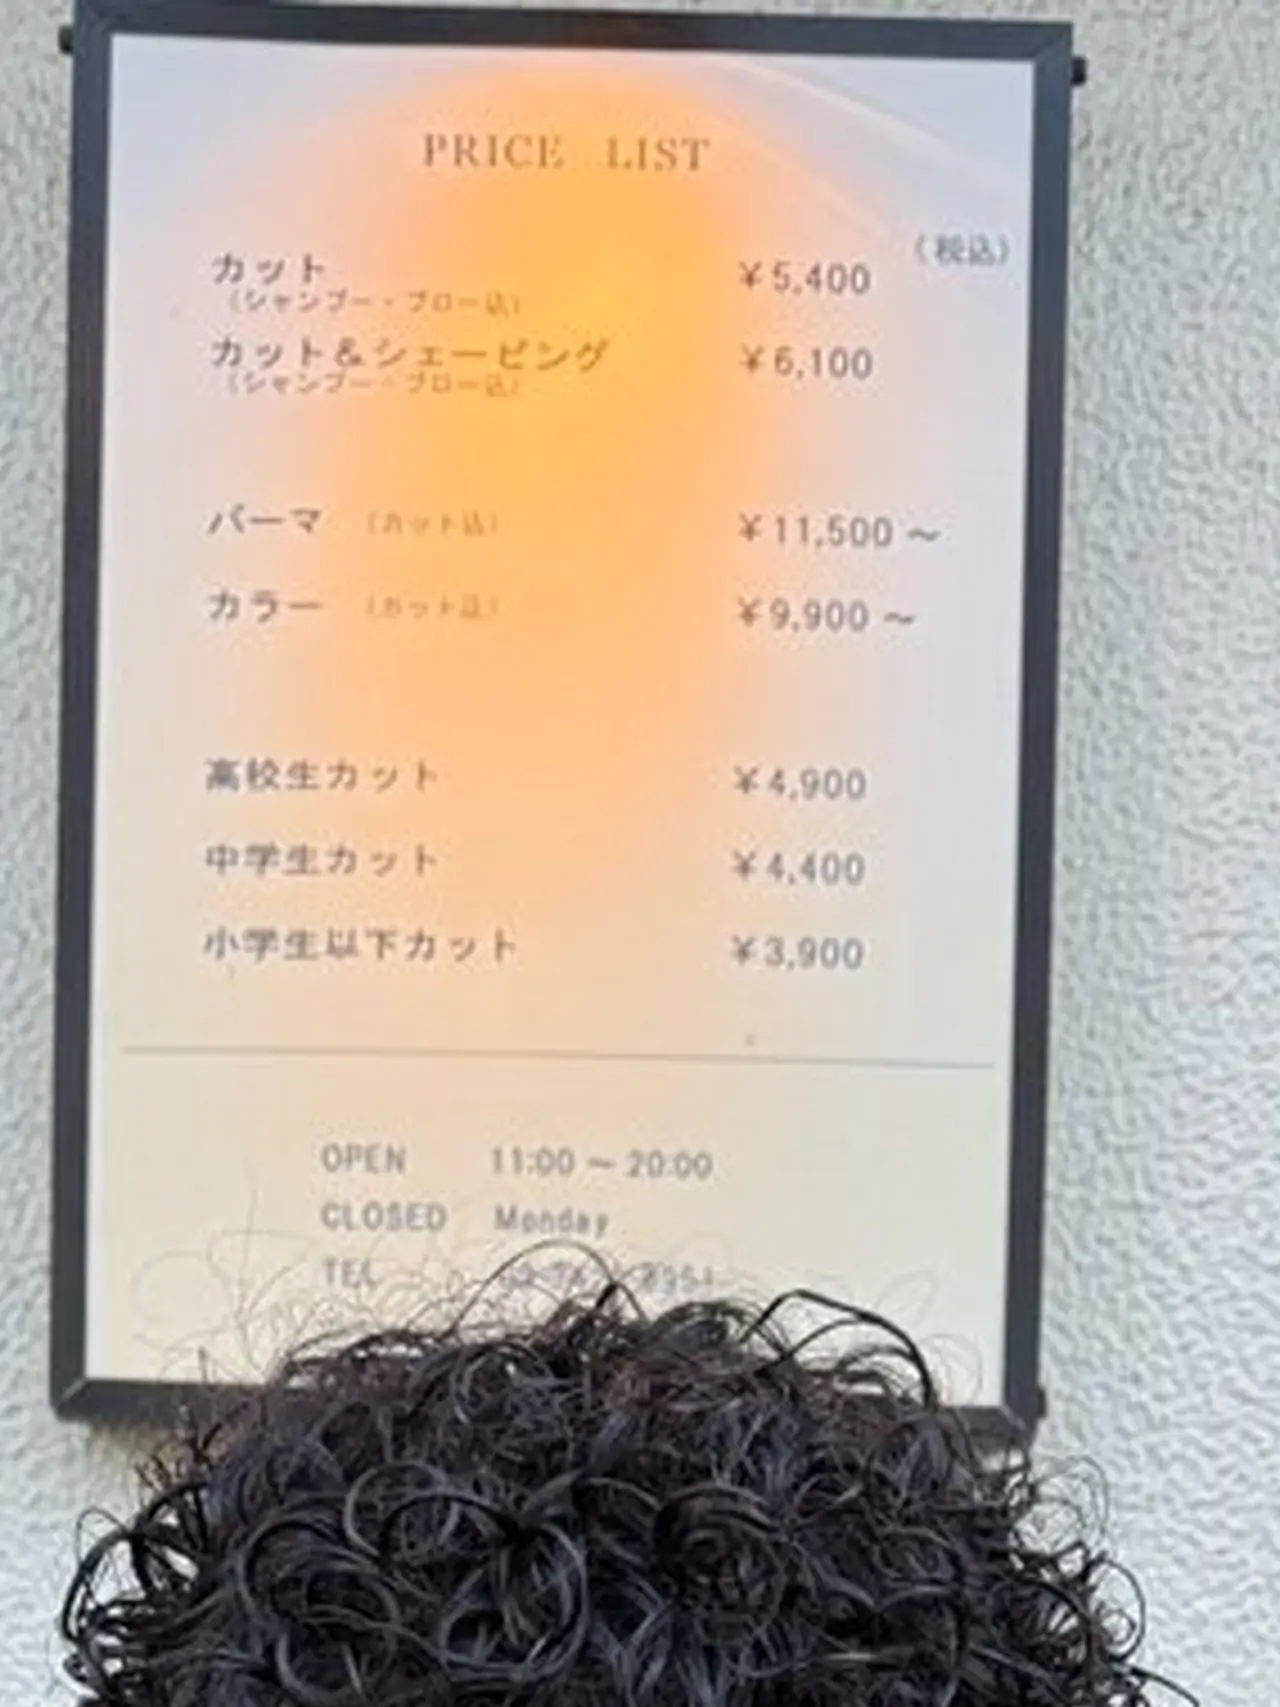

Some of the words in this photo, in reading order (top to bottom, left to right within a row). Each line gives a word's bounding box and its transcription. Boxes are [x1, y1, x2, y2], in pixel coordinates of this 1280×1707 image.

[424, 133, 564, 169] PRICE
[607, 136, 711, 172] LIST
[915, 234, 1010, 266] （税込）
[212, 252, 325, 285] カット
[739, 260, 871, 295] ¥5,400
[741, 344, 874, 380] ¥6,100
[208, 589, 323, 624] カラー
[205, 757, 439, 793] 高校生カット
[734, 766, 867, 801] ¥4,900
[204, 841, 439, 877] 中学生カット
[731, 849, 866, 886] ¥4,400
[203, 926, 517, 963] 小学生以下カット
[731, 935, 864, 971] ¥3,900
[320, 1142, 406, 1175] OPEN
[320, 1199, 449, 1234] CLOSED
[495, 1203, 609, 1237] Monday
